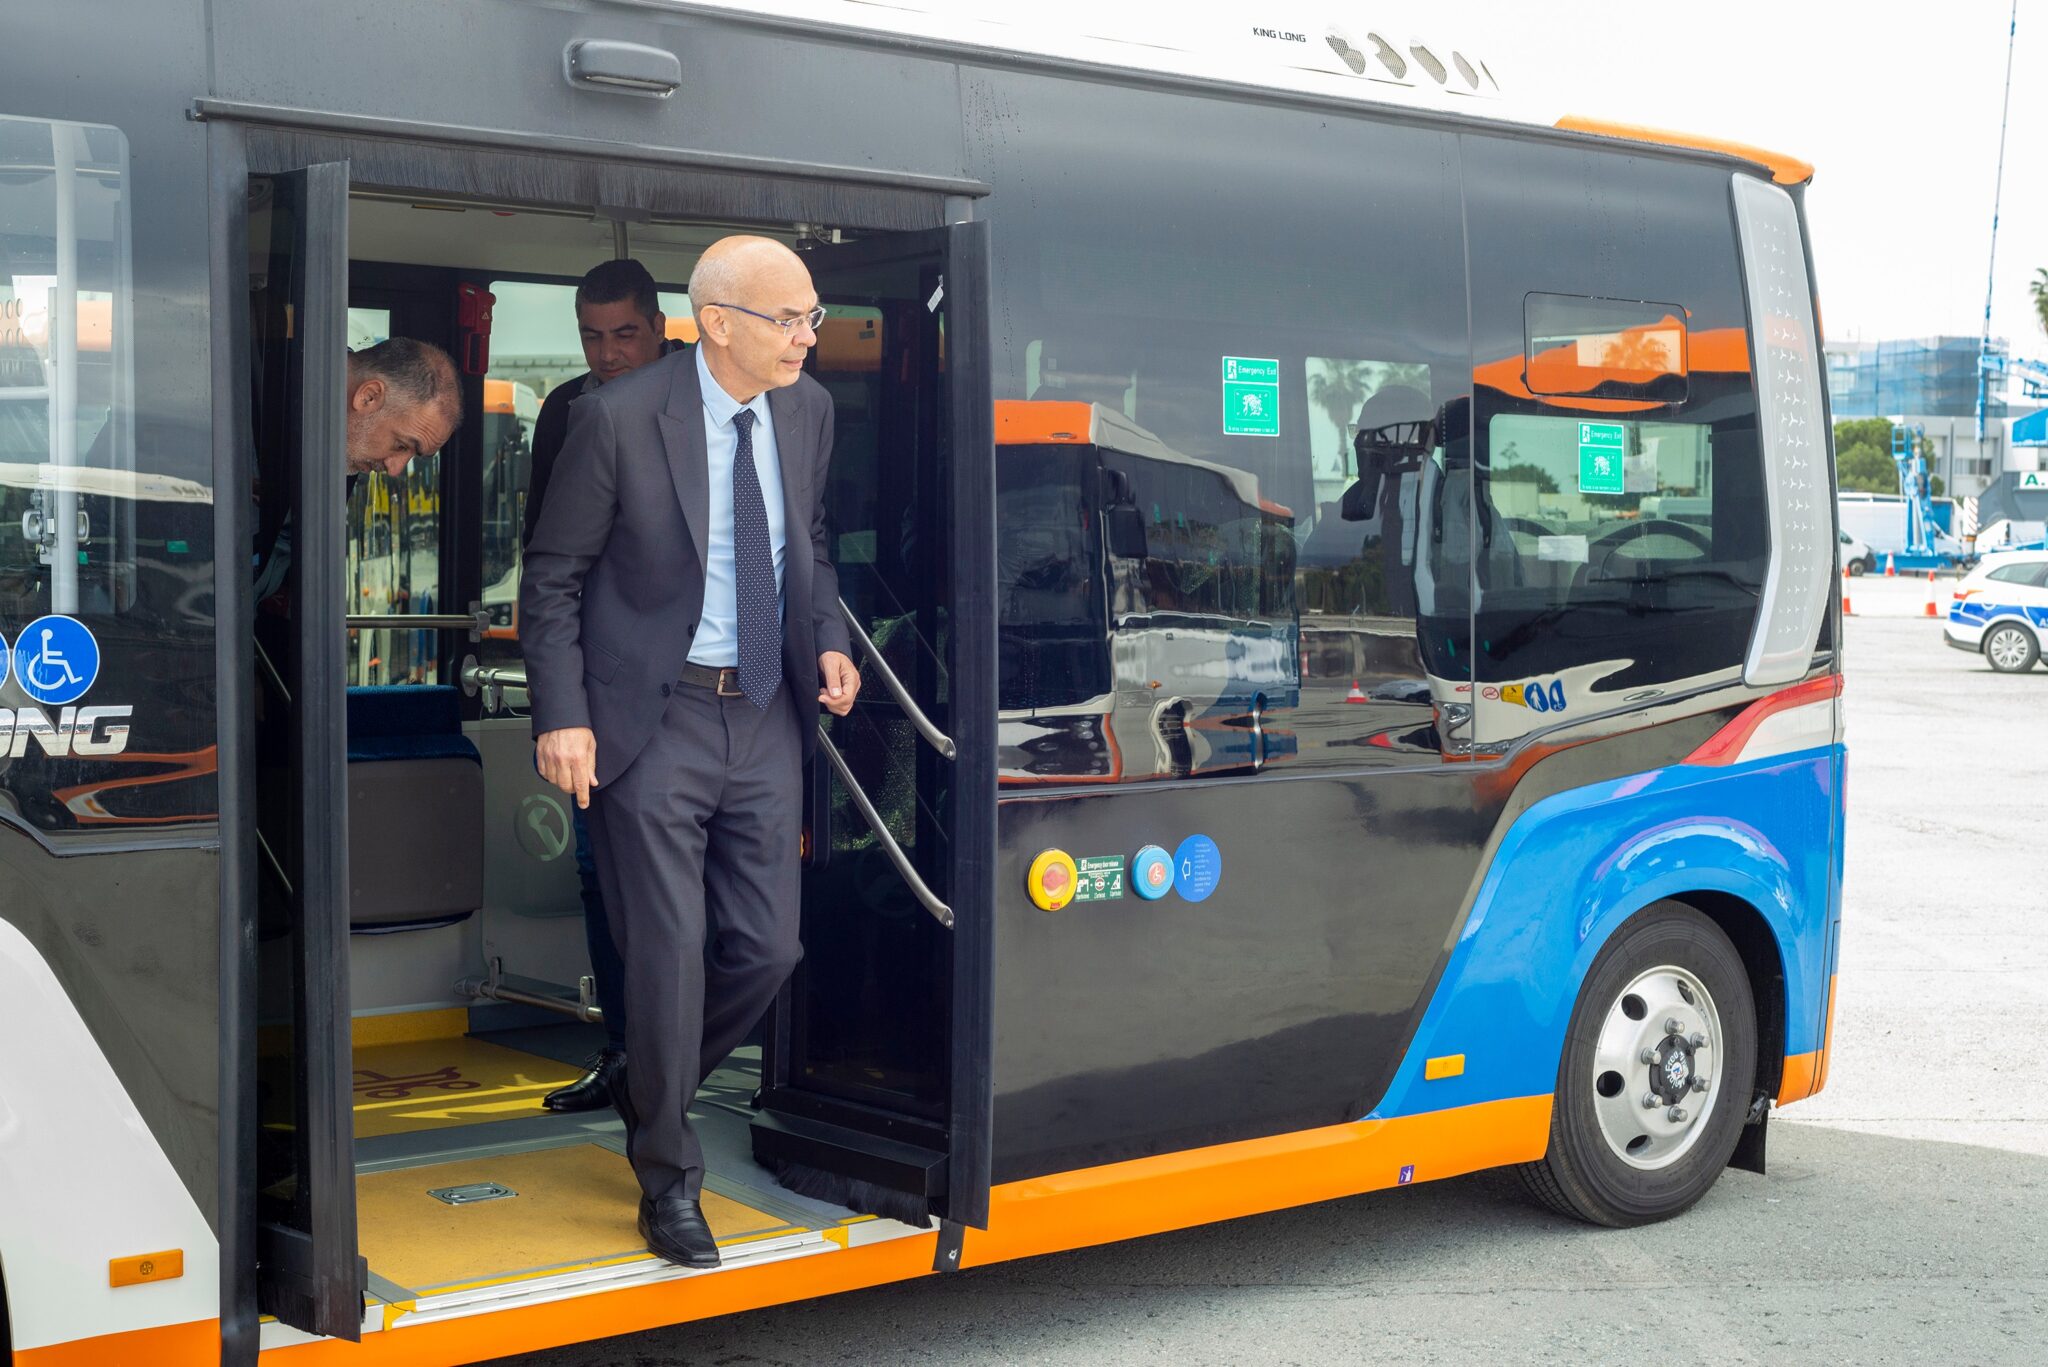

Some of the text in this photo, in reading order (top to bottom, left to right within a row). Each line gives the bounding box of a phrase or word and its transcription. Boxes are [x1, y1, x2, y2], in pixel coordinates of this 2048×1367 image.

[1253, 27, 1306, 43] KING LONG
[1238, 365, 1265, 377] Emergency
[0, 705, 133, 758] NG
